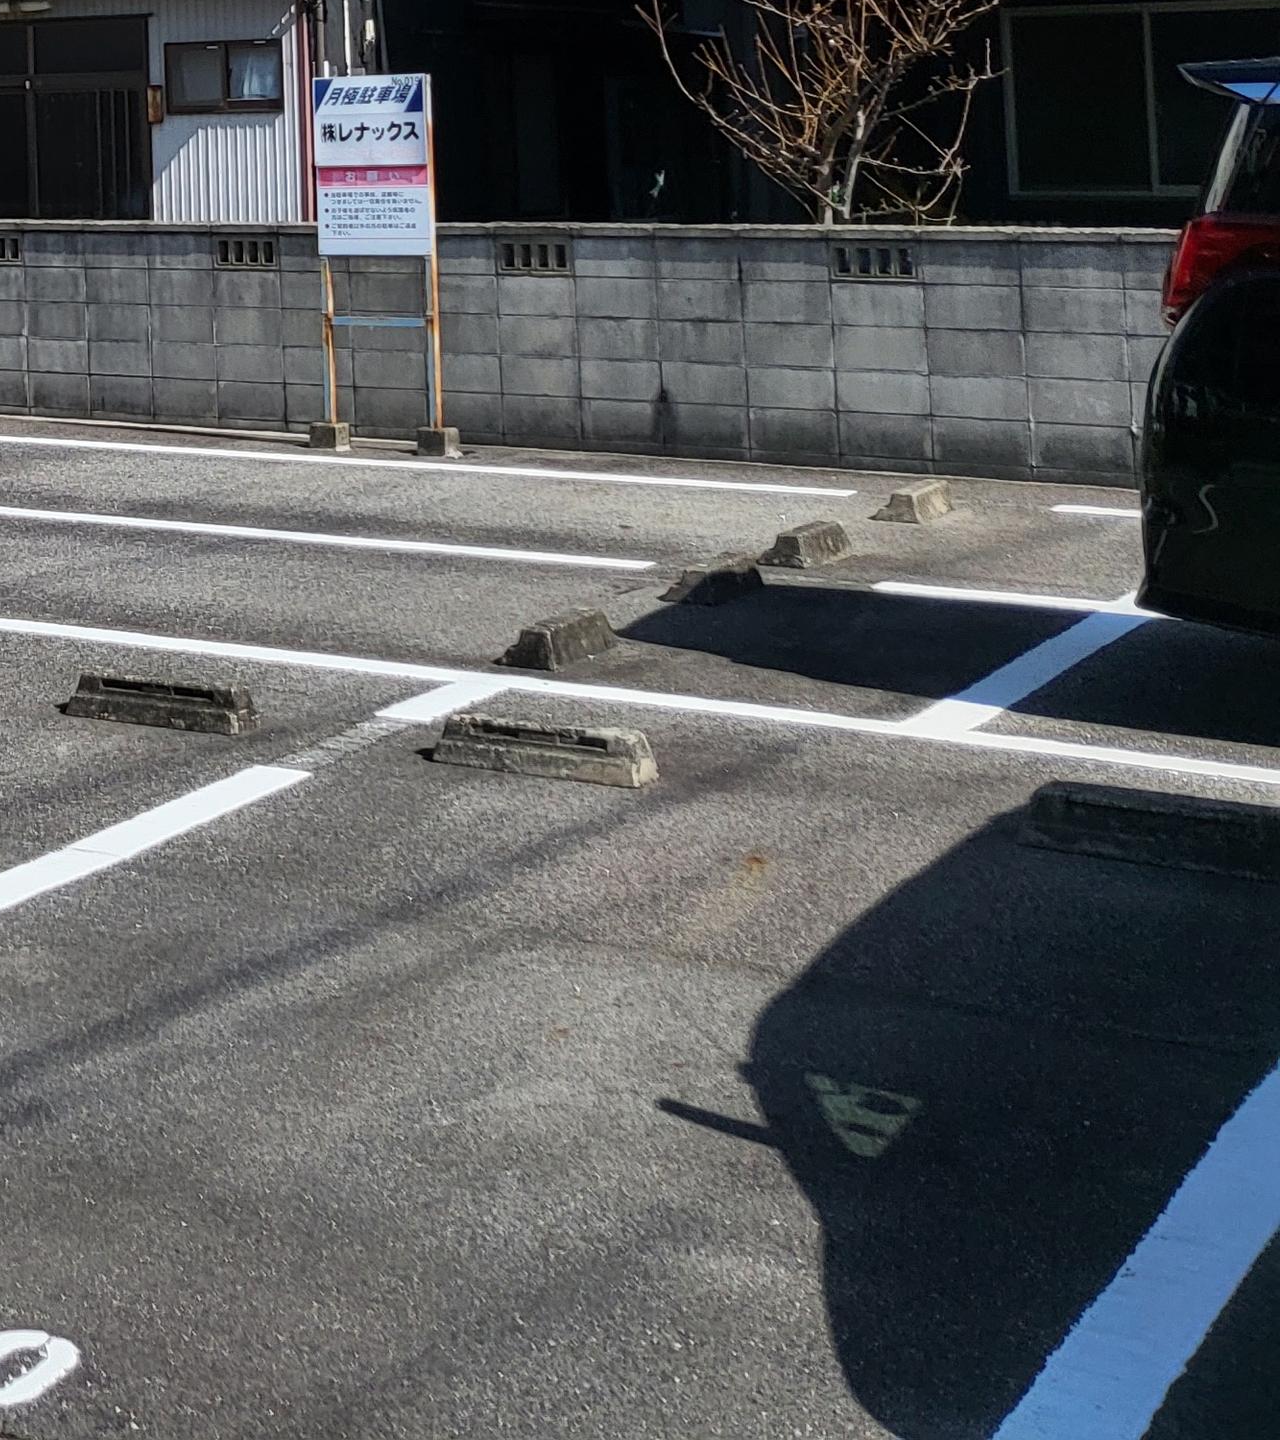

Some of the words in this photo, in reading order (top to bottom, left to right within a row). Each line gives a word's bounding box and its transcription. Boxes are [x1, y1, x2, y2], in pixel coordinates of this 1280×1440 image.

[324, 85, 413, 106] 月極駐車場
